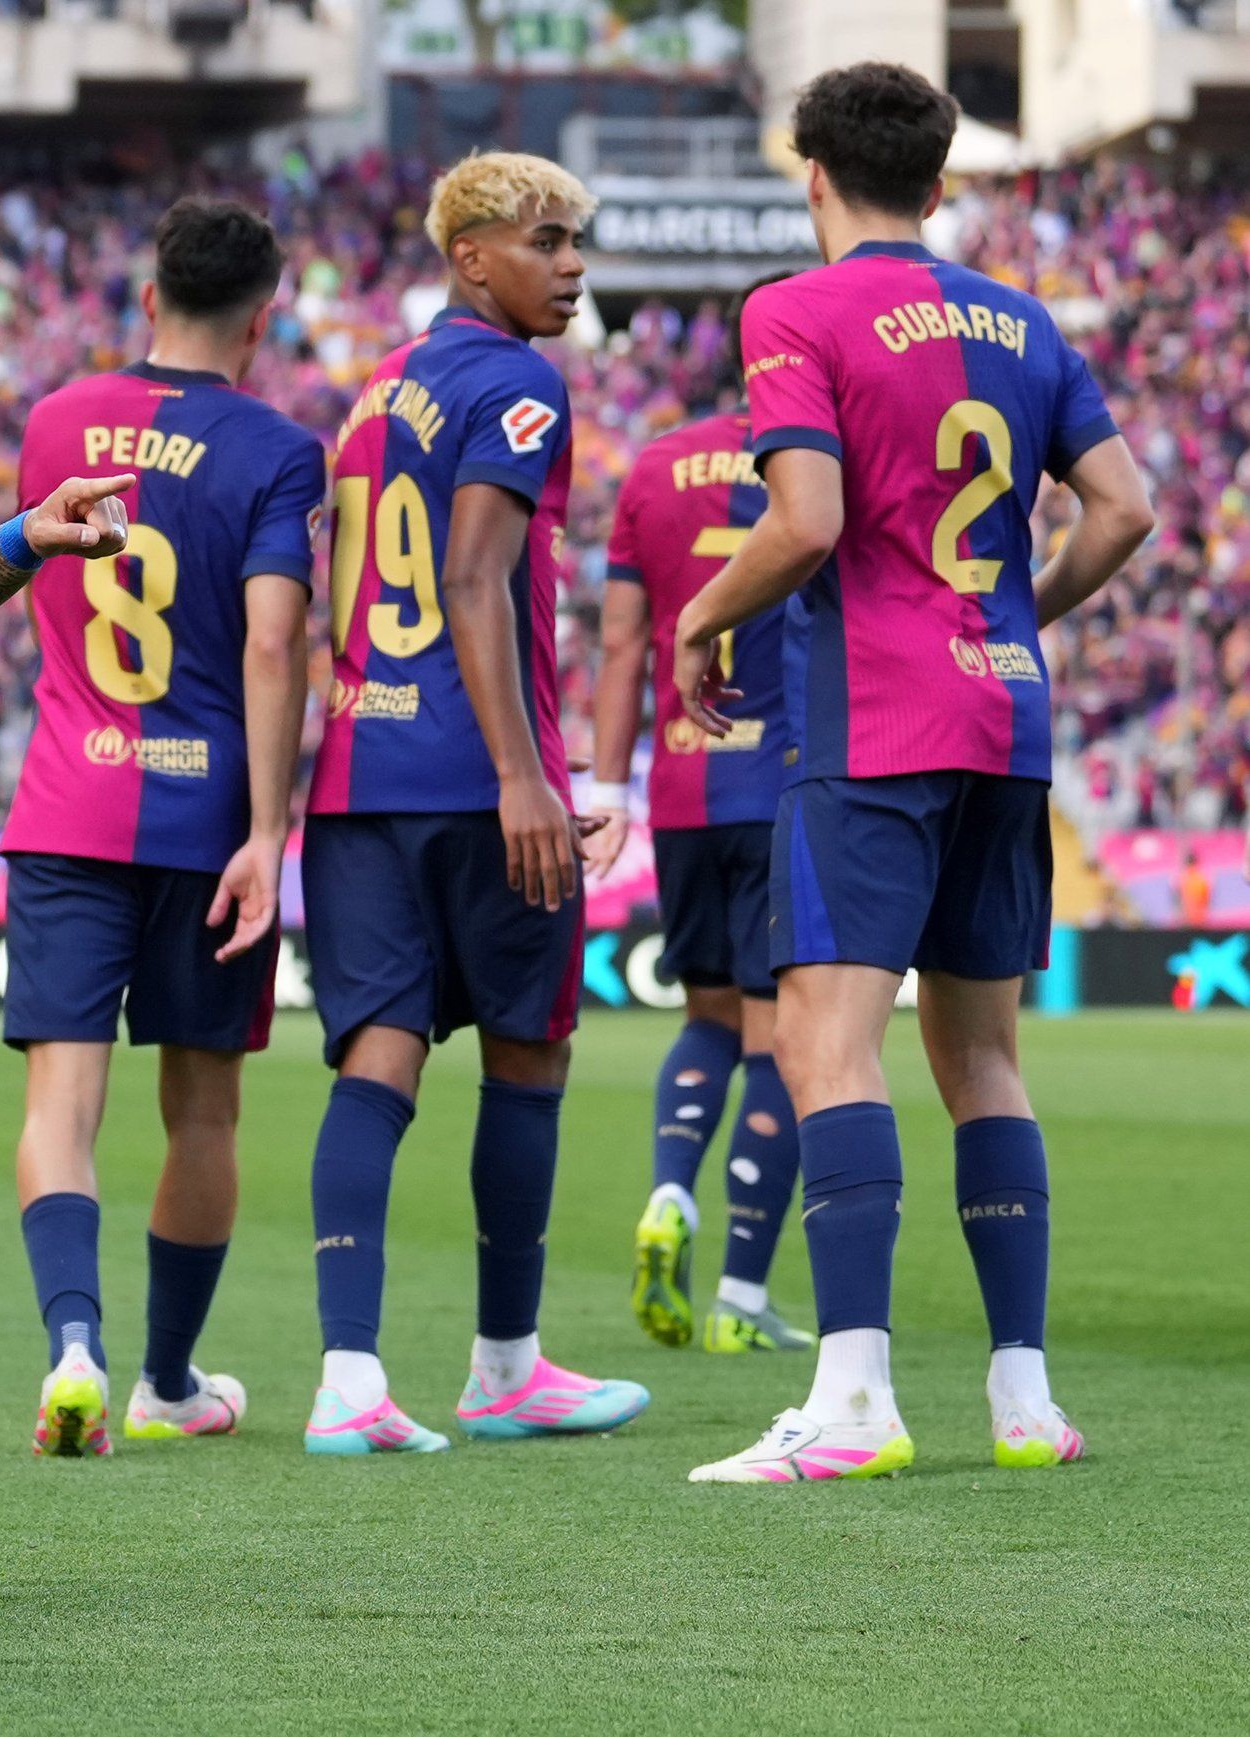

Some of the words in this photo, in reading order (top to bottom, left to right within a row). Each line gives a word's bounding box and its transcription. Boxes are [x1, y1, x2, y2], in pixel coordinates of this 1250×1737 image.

[593, 206, 816, 253] BARCELON
[83, 426, 207, 479] PEDRI
[672, 452, 769, 492] FERR
[932, 400, 1013, 594] 2
[328, 472, 445, 659] 19
[83, 523, 178, 705] 8
[132, 738, 208, 754] UNHCR
